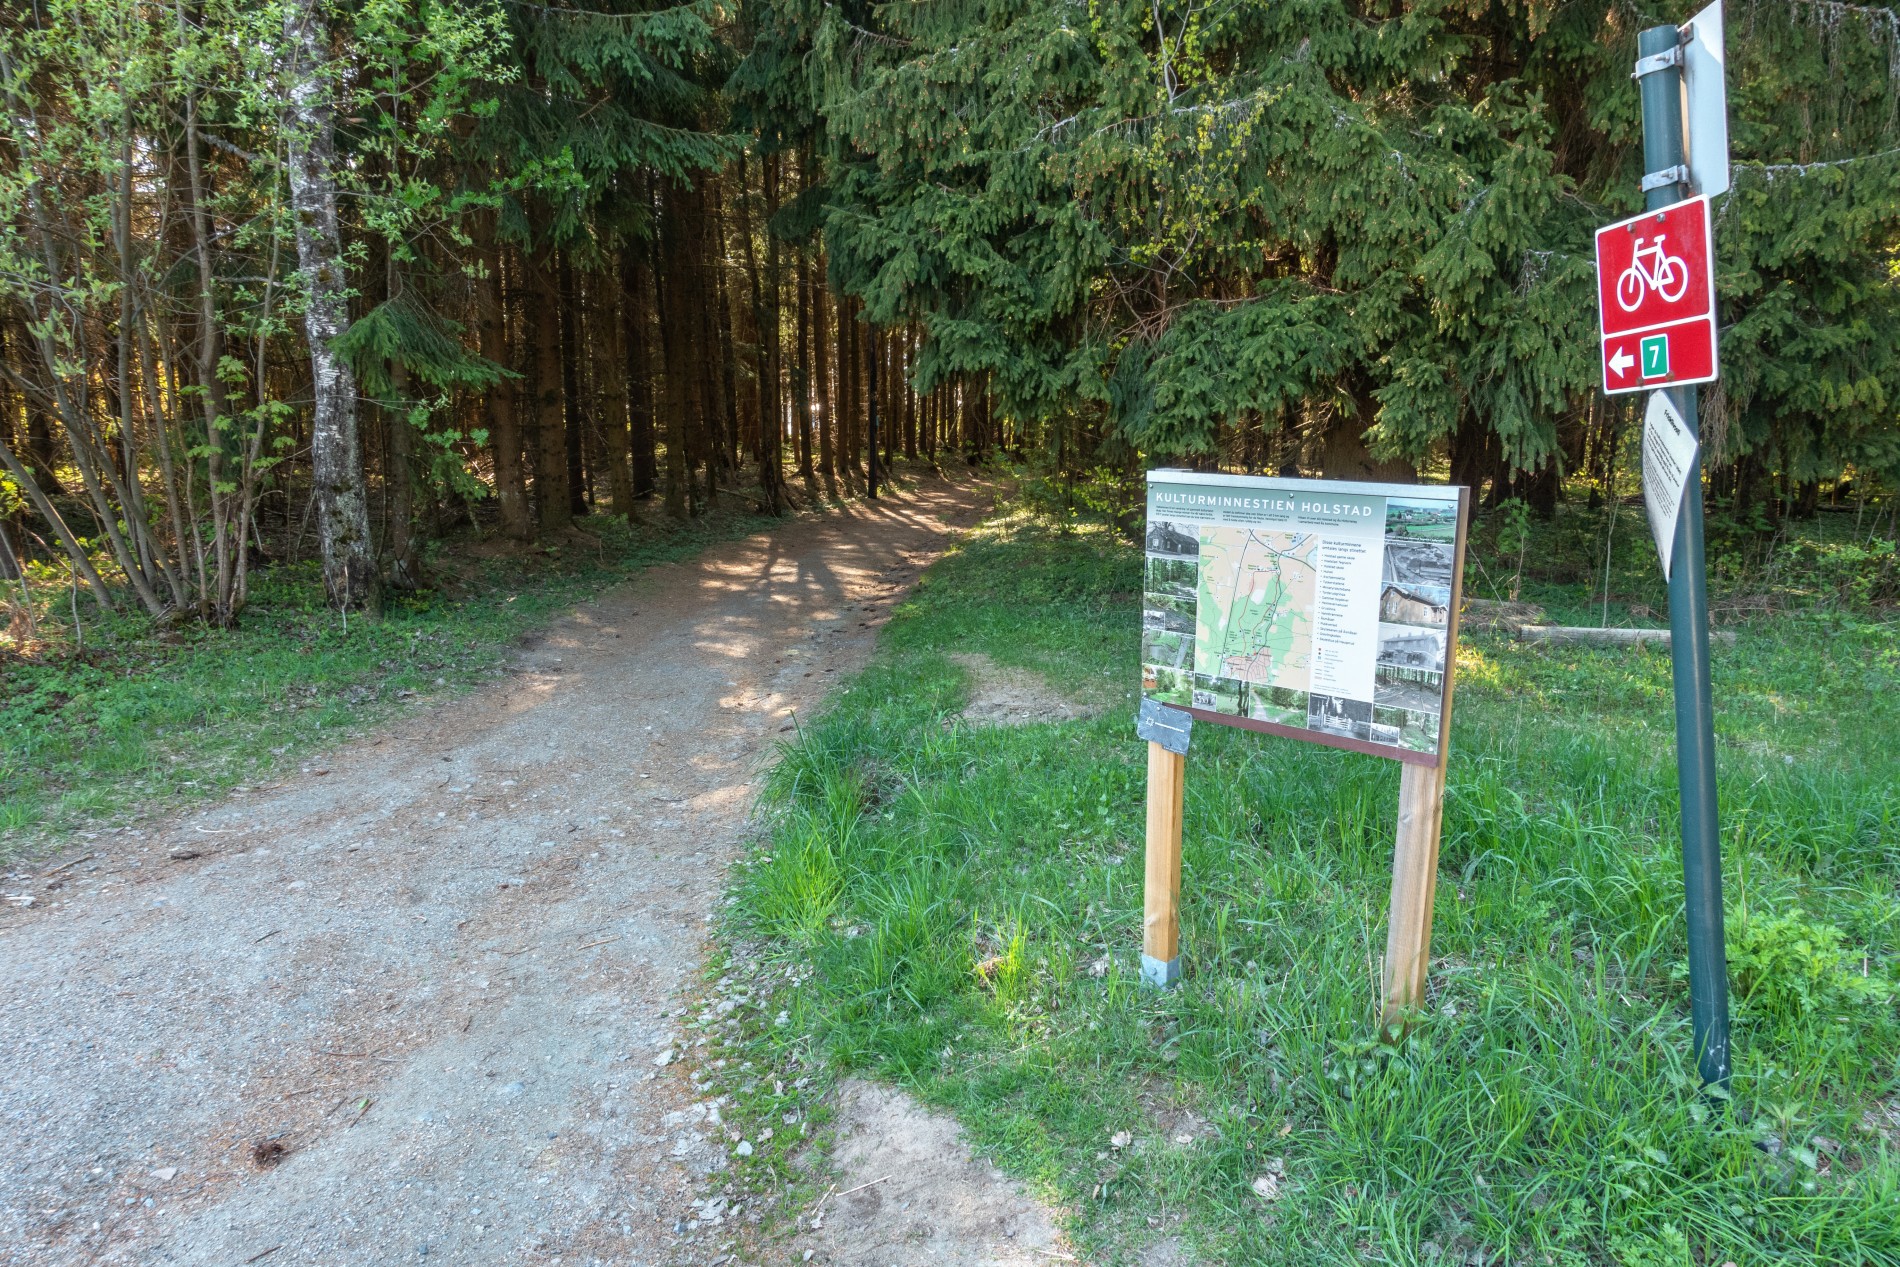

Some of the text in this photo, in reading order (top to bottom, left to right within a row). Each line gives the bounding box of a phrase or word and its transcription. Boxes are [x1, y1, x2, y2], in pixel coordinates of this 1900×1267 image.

[1649, 345, 1659, 368] 7
[1156, 492, 1372, 517] KULTURMINNESTIEN HOLSTAD
